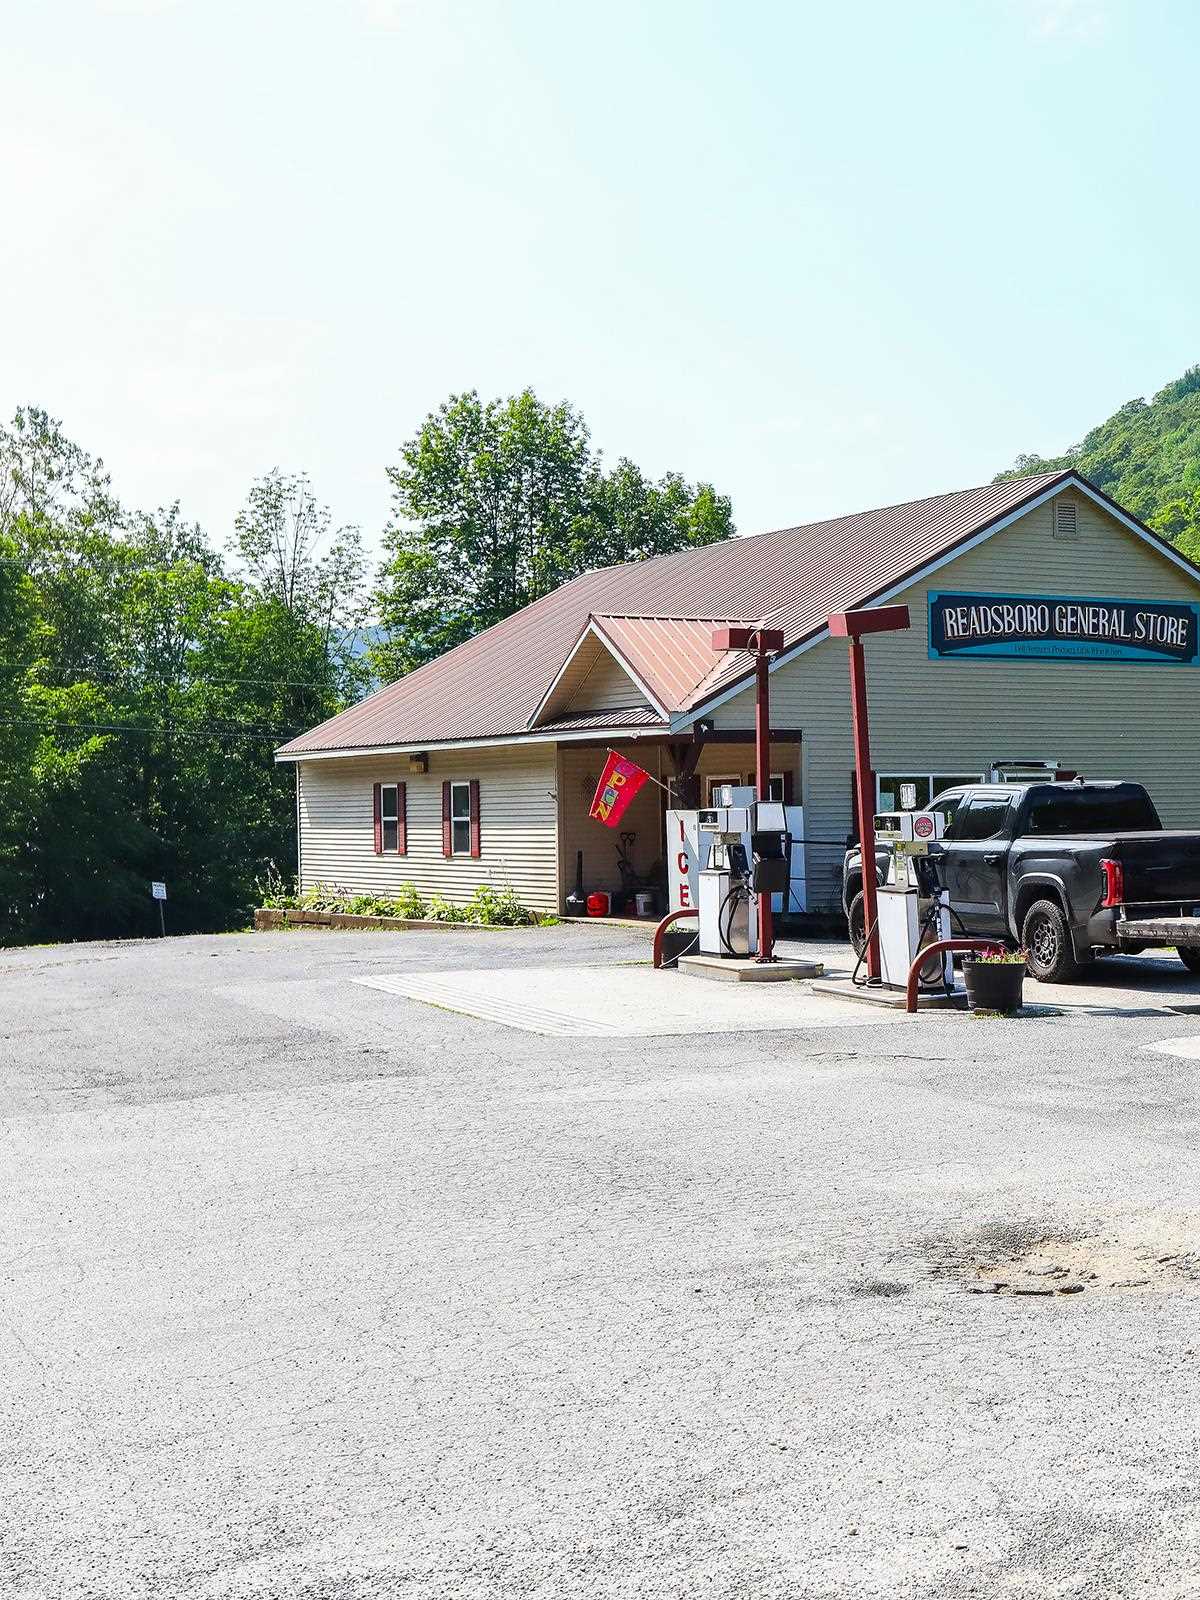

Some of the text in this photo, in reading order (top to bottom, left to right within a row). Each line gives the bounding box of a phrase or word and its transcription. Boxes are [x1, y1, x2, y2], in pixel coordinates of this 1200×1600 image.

[943, 604, 1189, 646] READSBORO GENERAL STORE
[678, 820, 690, 907] ICE
